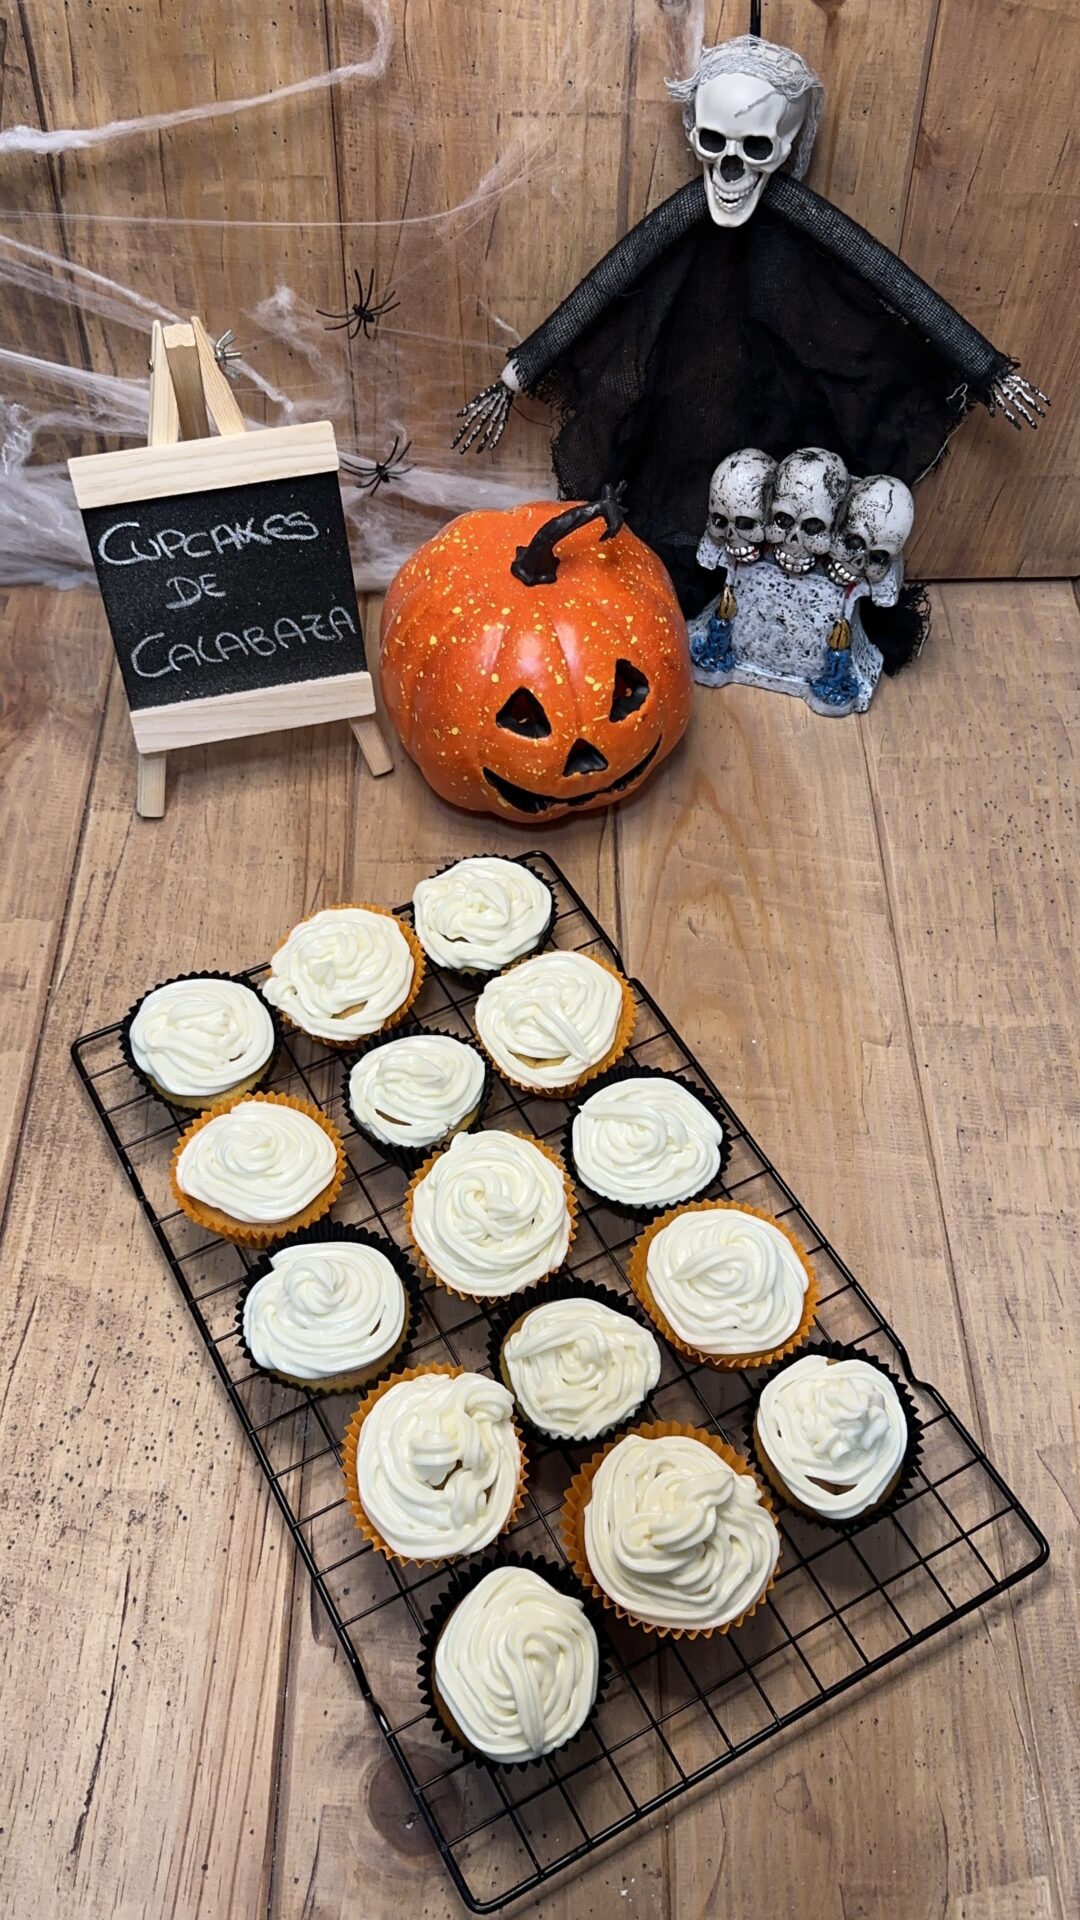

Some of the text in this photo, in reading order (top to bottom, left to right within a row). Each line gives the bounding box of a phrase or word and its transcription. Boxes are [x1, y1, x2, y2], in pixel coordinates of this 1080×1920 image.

[98, 511, 319, 565] CUPCAKES
[166, 573, 226, 609] DE
[130, 606, 356, 678] CALABAZA
